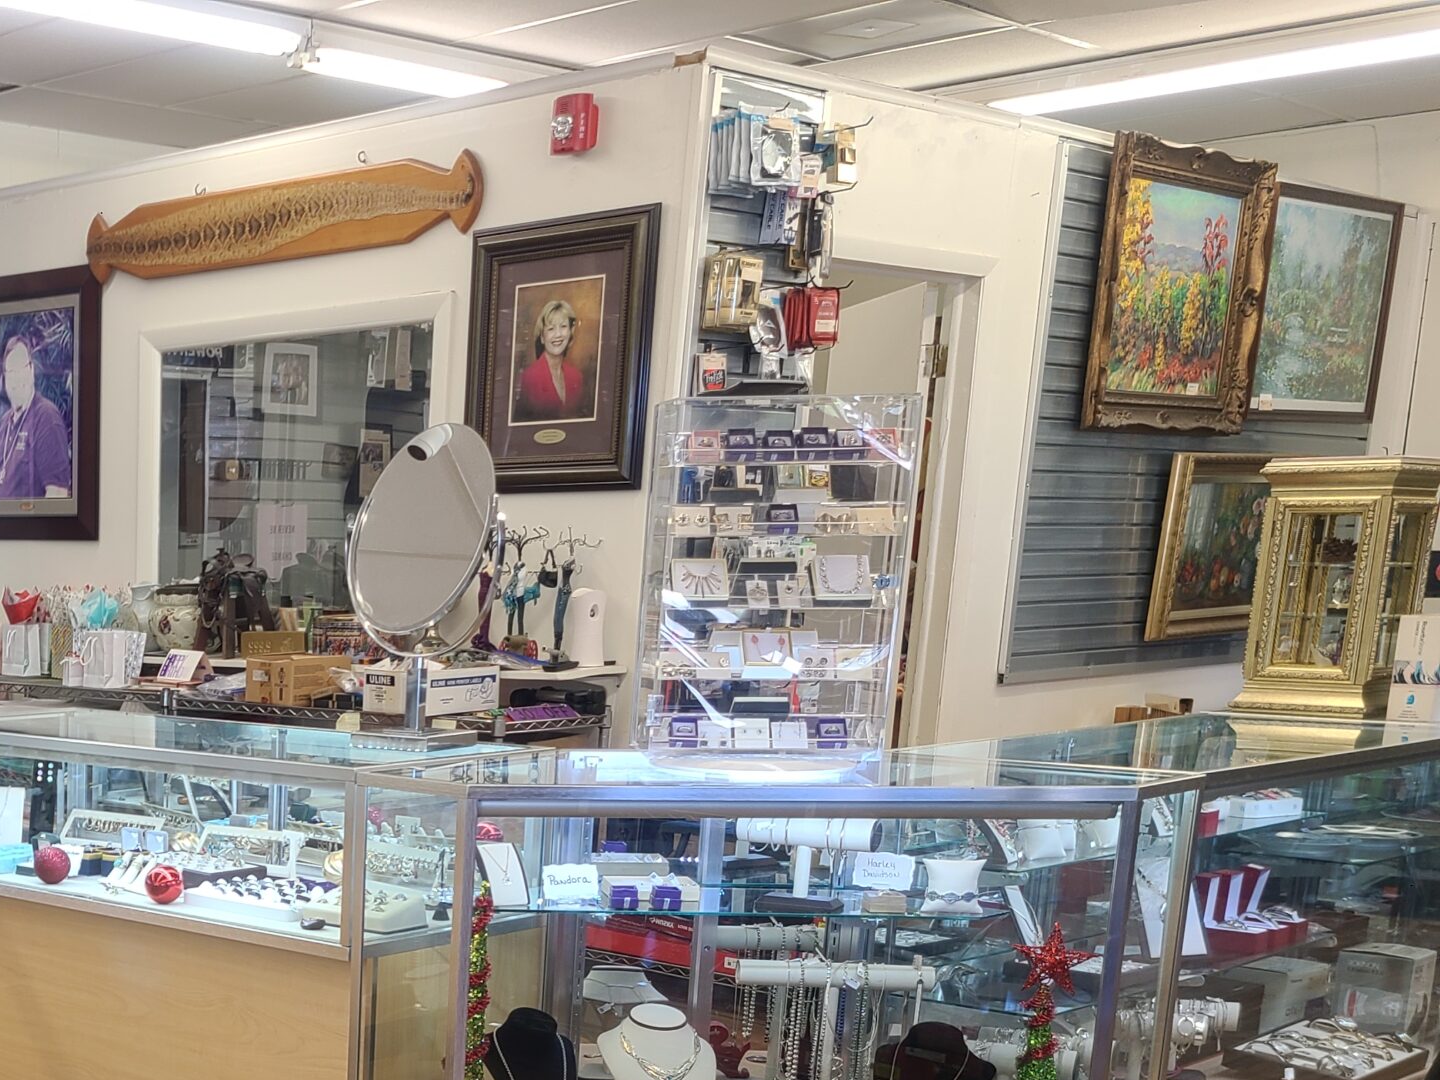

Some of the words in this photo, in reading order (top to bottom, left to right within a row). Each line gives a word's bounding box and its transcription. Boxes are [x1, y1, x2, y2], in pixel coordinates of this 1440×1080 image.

[368, 675, 392, 686] ULINE
[867, 857, 896, 870] Harley
[546, 874, 592, 886] Pandora
